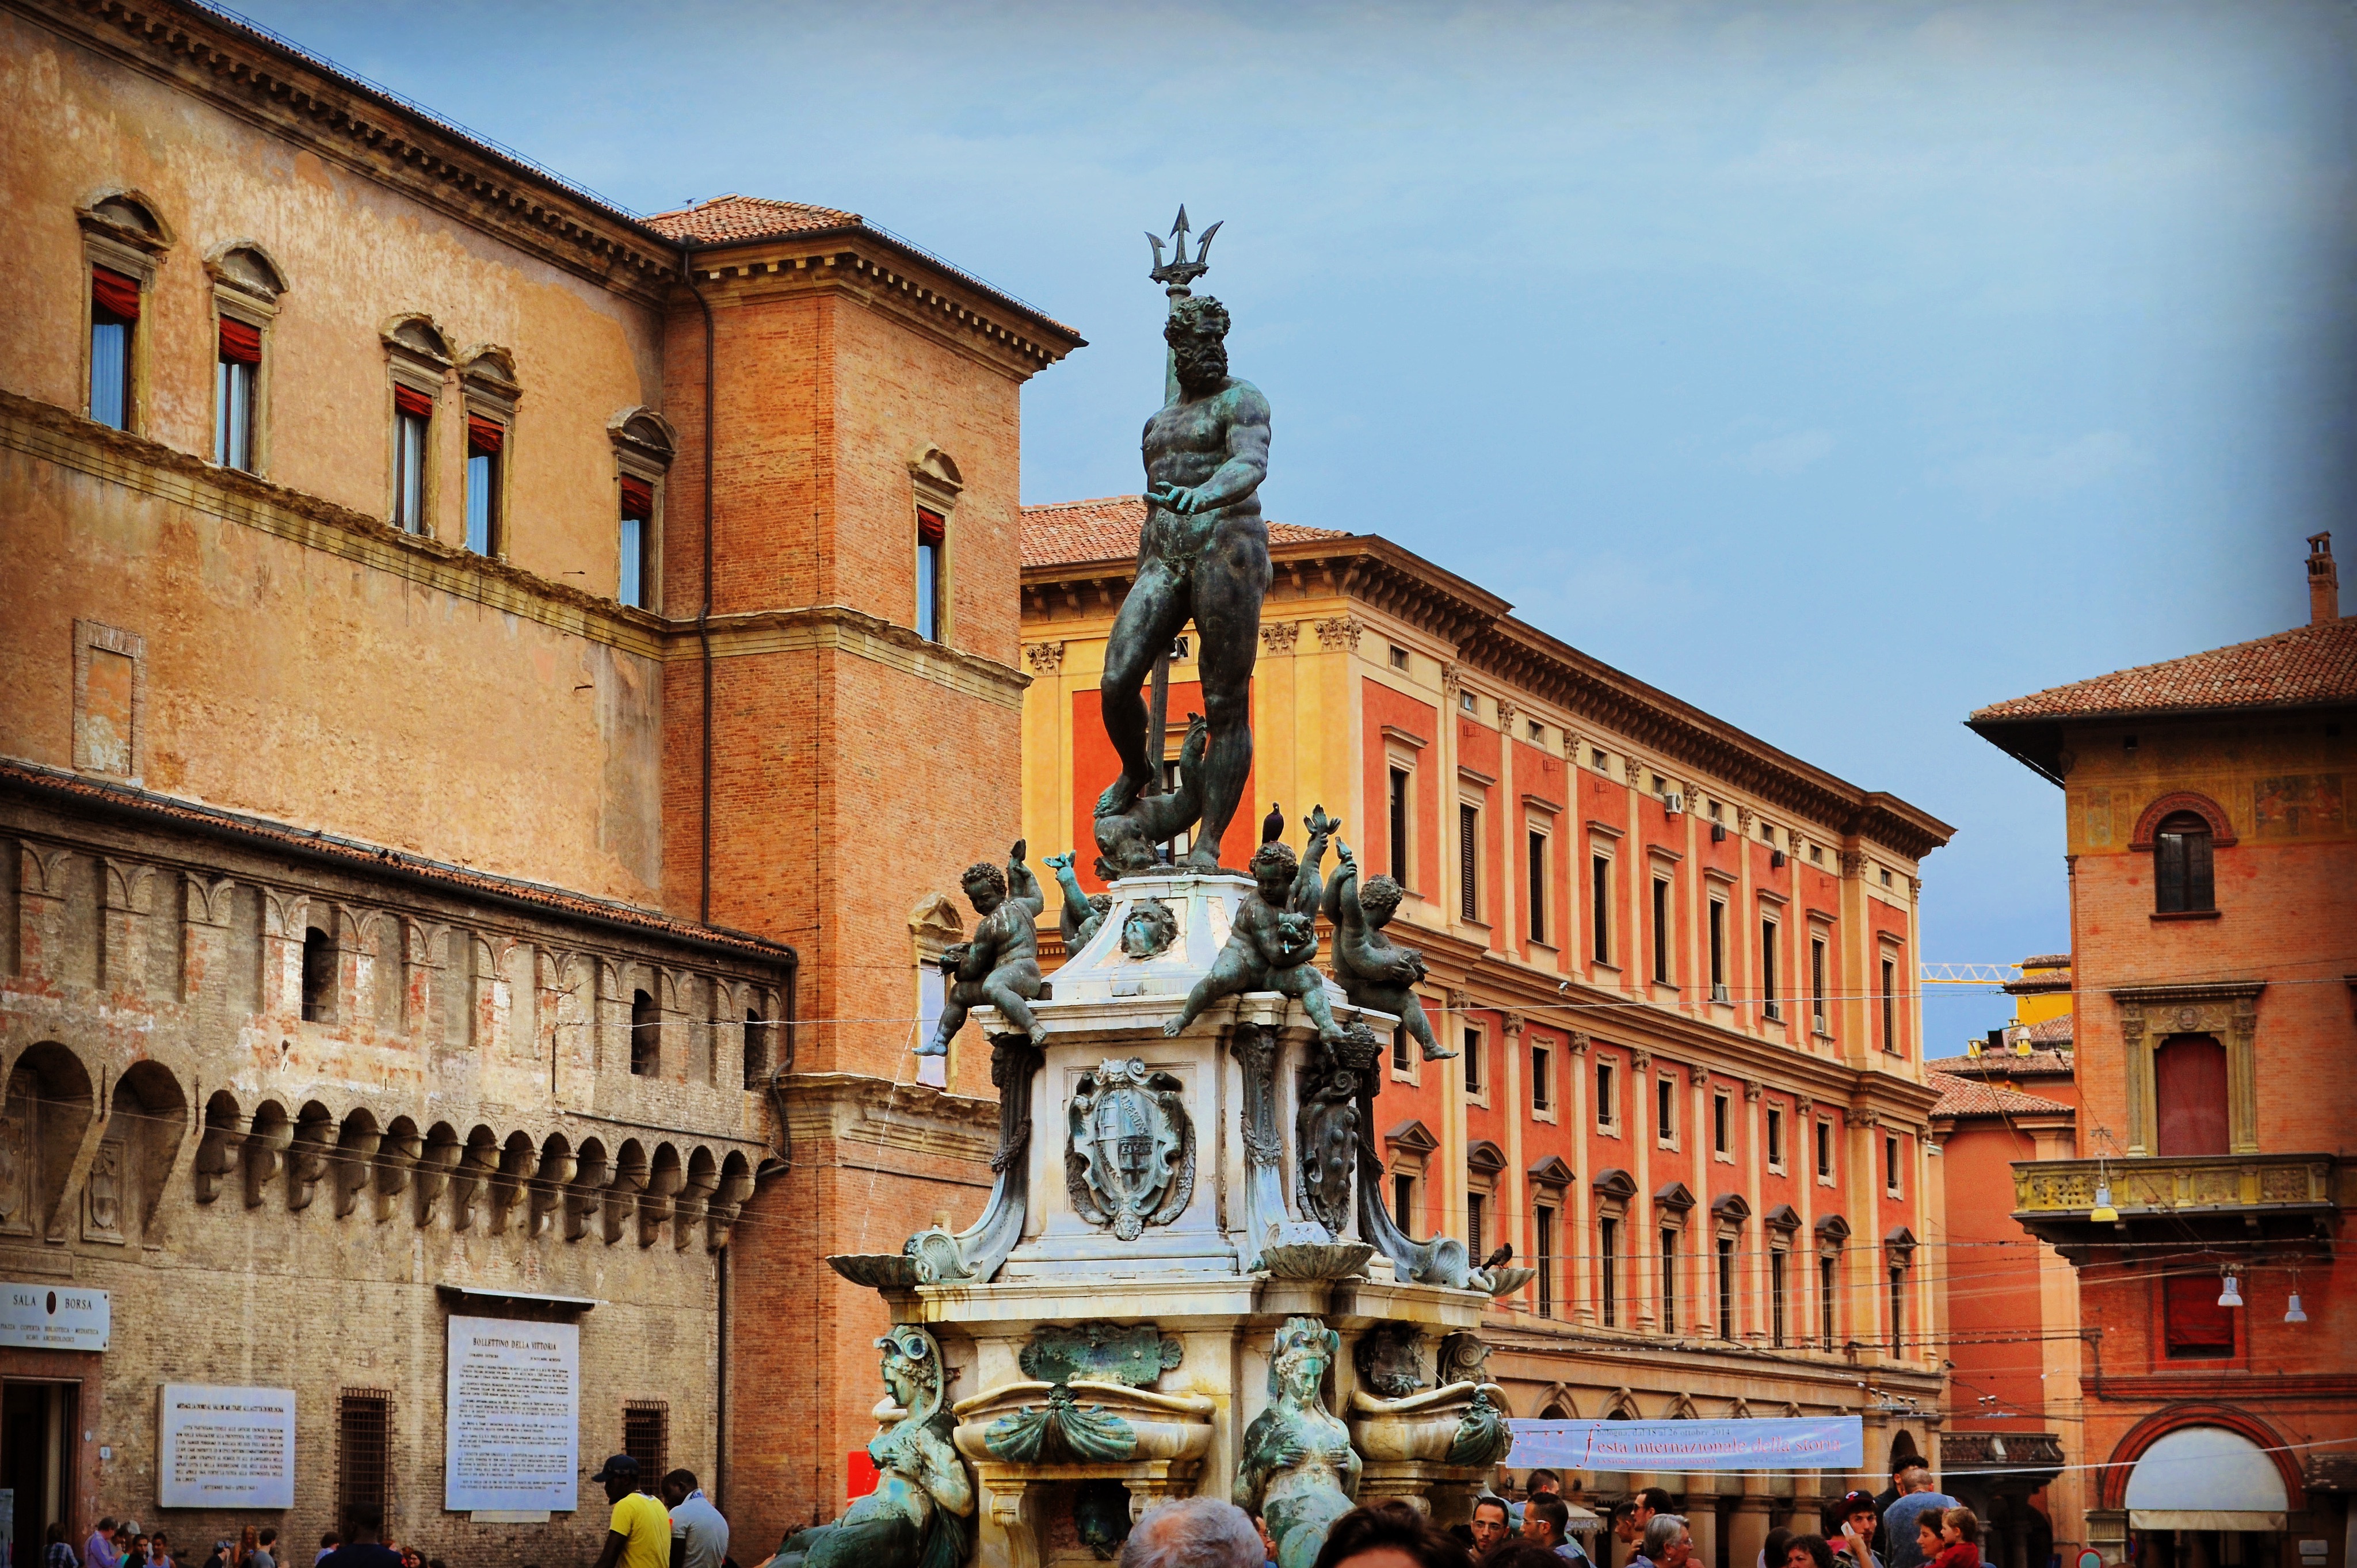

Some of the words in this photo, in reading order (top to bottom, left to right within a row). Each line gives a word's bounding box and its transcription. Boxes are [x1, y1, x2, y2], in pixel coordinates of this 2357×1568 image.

[1121, 1095, 1148, 1135] LIBERTAS
[13, 1294, 36, 1306] SALA
[65, 1298, 92, 1310] BORSA
[473, 1337, 509, 1347] BOLLETTINO
[511, 1340, 529, 1349] DELLA
[532, 1342, 556, 1350] VITTORIA
[1633, 1428, 1645, 1436] dal
[1647, 1428, 1657, 1436] 18
[1659, 1428, 1666, 1436] al
[1669, 1428, 1677, 1436] 26
[1680, 1428, 1709, 1436] ottobre
[1712, 1428, 1730, 1436] 2014
[1635, 1437, 1746, 1453] internazionale
[1751, 1437, 1790, 1453] della
[1795, 1436, 1841, 1452] storia
